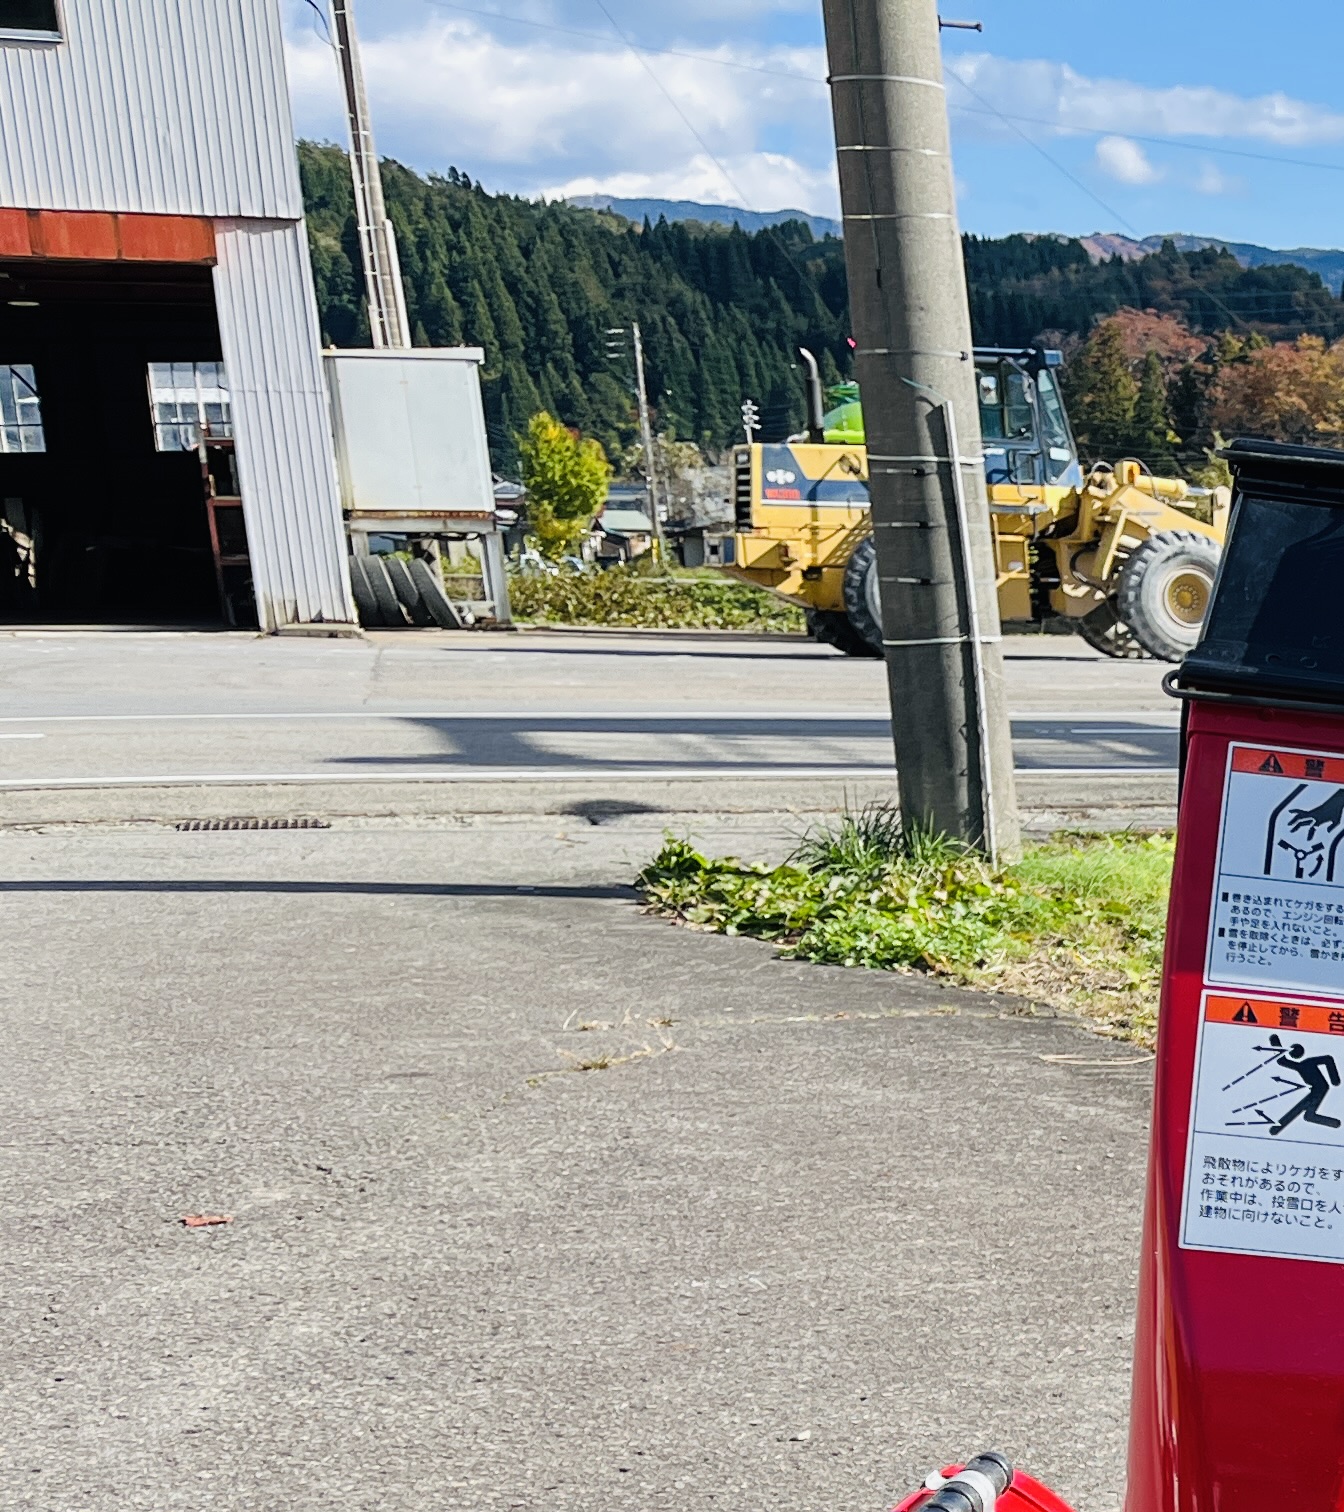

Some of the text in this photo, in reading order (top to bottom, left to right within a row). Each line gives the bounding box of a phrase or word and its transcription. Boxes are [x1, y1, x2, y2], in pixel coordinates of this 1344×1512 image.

[1225, 952, 1272, 967] 行うこと。
[1202, 1173, 1322, 1197] おそれがあるので、
[1198, 1204, 1333, 1230] 建物に向けないこと。
